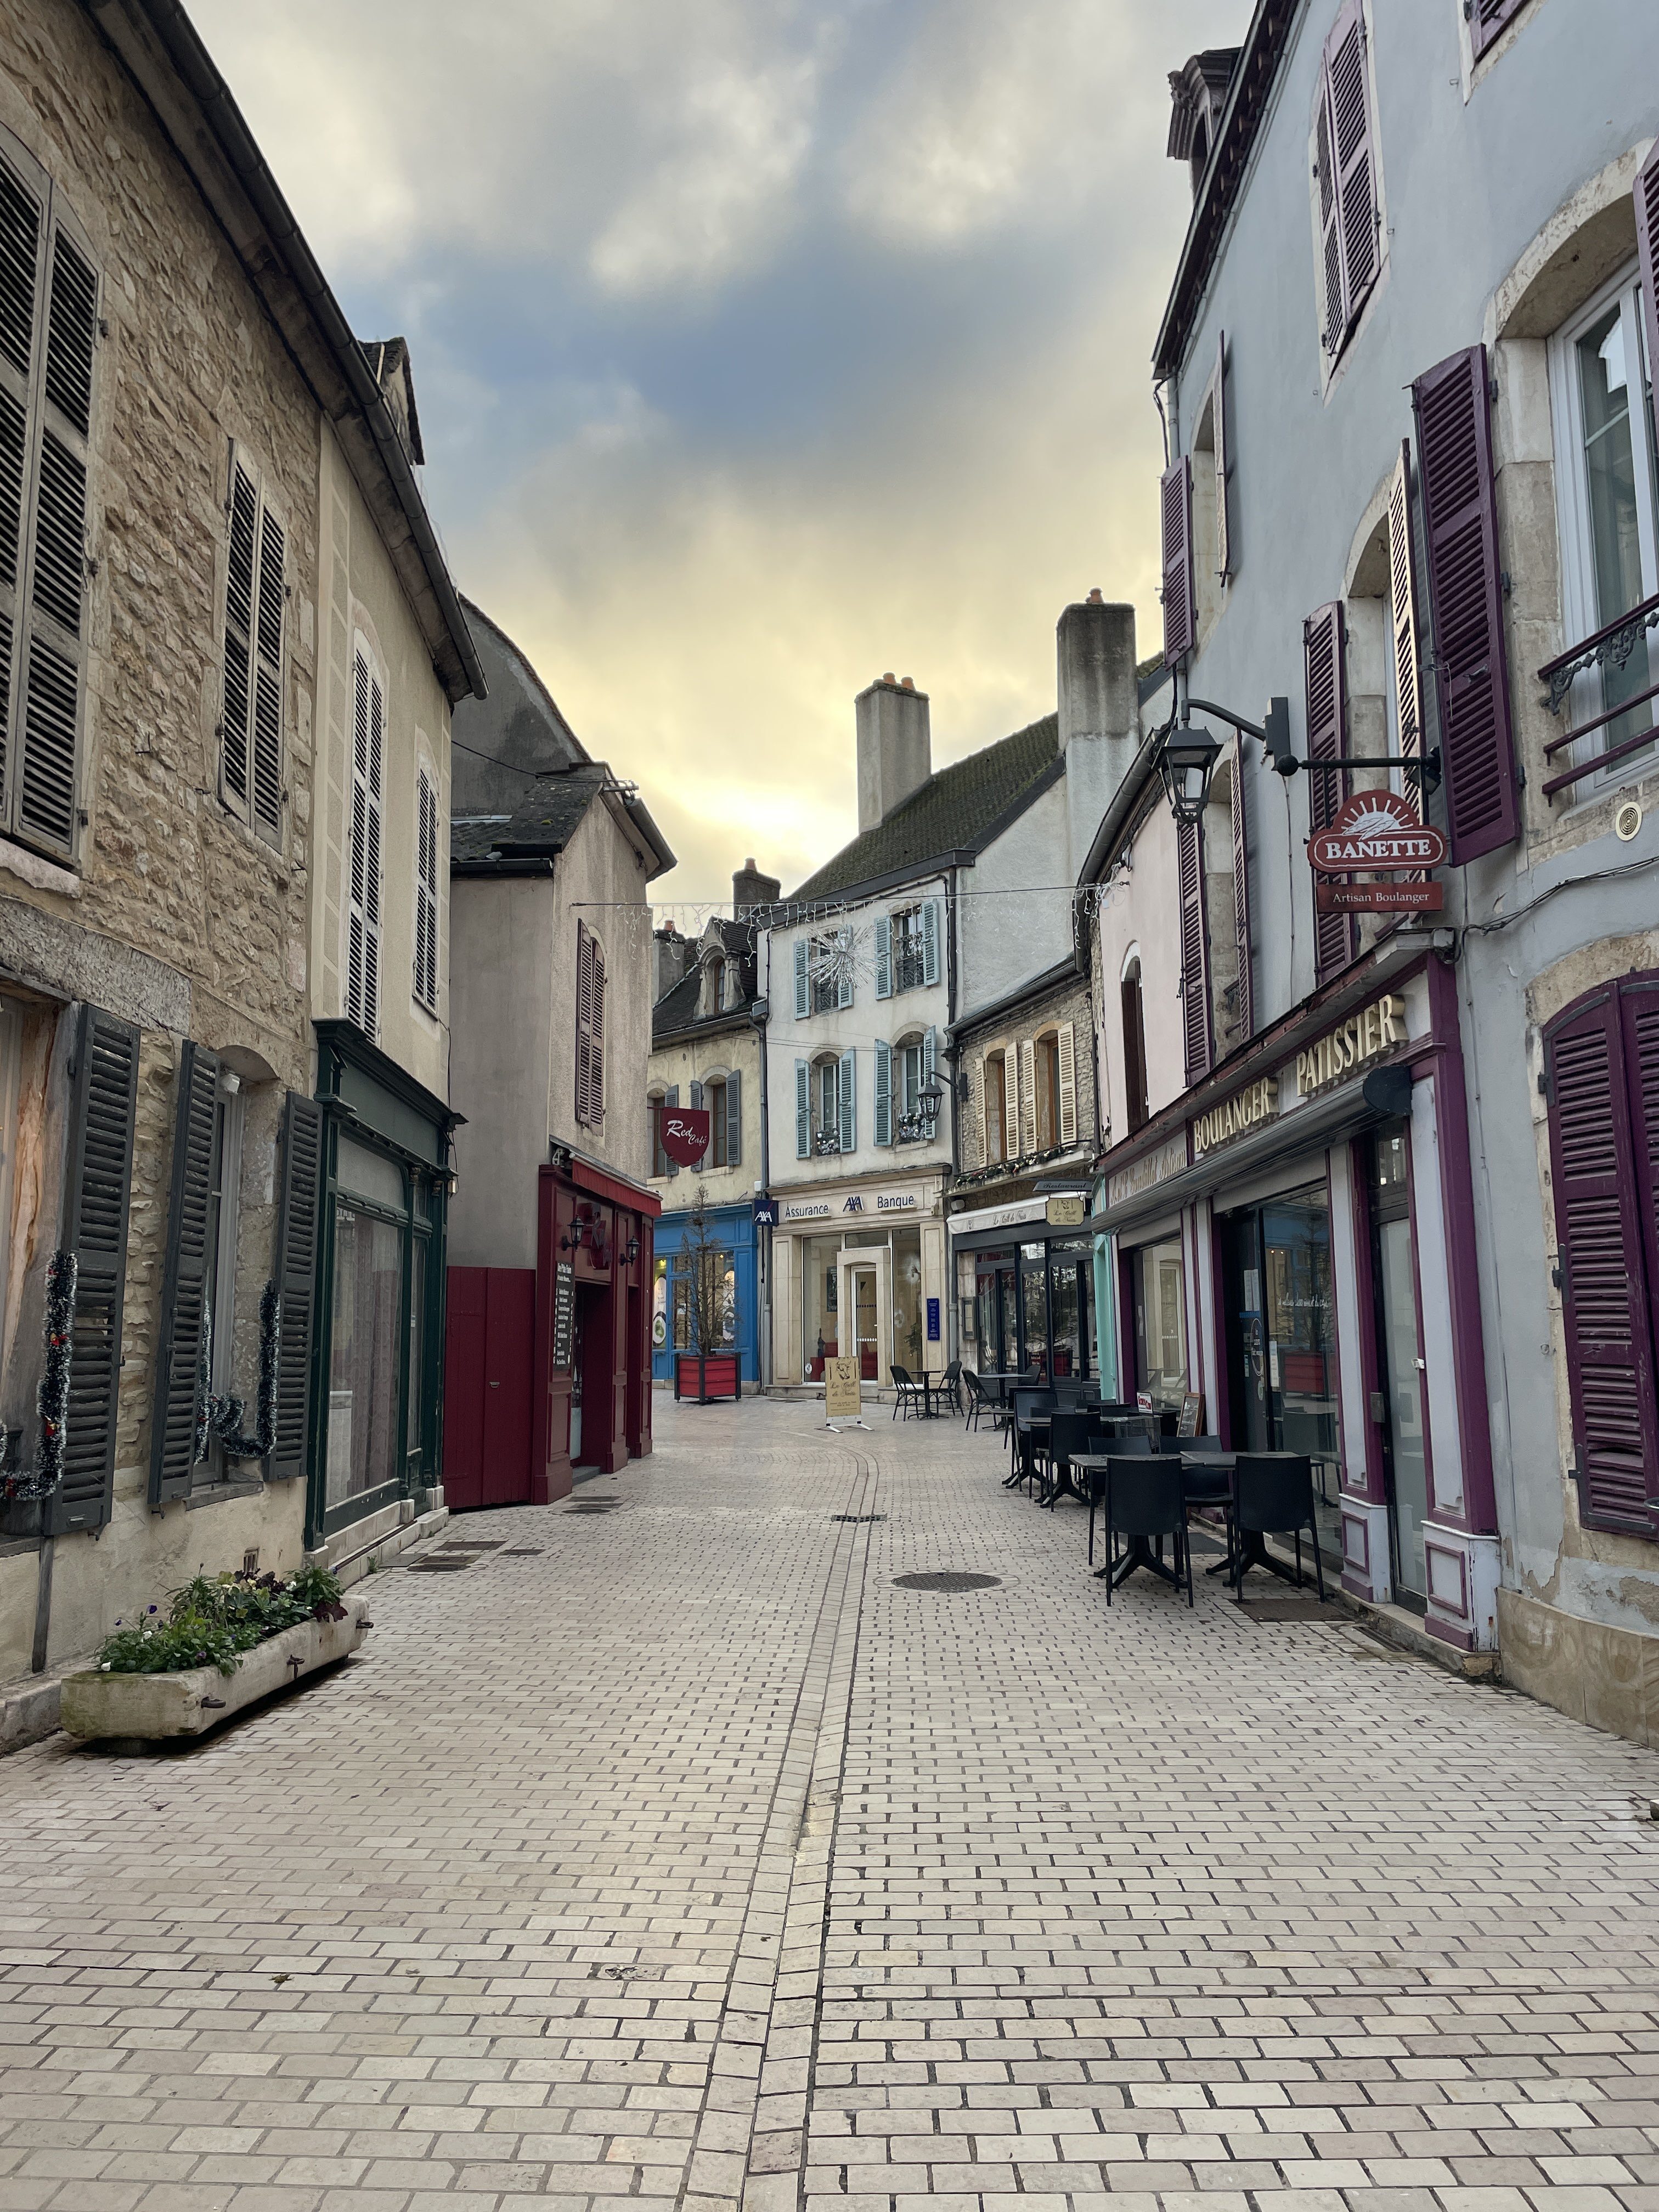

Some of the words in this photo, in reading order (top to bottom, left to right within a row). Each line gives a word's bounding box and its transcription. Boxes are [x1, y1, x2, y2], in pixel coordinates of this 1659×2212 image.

[1325, 839, 1431, 859] BANETTE
[1333, 894, 1372, 902] Artisan
[1375, 891, 1430, 904] Boulanger
[1194, 1076, 1277, 1153] BOULANGER
[1296, 994, 1402, 1097] PATISSIER
[666, 1119, 693, 1138] Red
[688, 1134, 707, 1147] Café
[785, 1204, 828, 1218] Assurance
[843, 1196, 864, 1212] AXA
[877, 1195, 915, 1210] Banque
[754, 1211, 772, 1222] AXA
